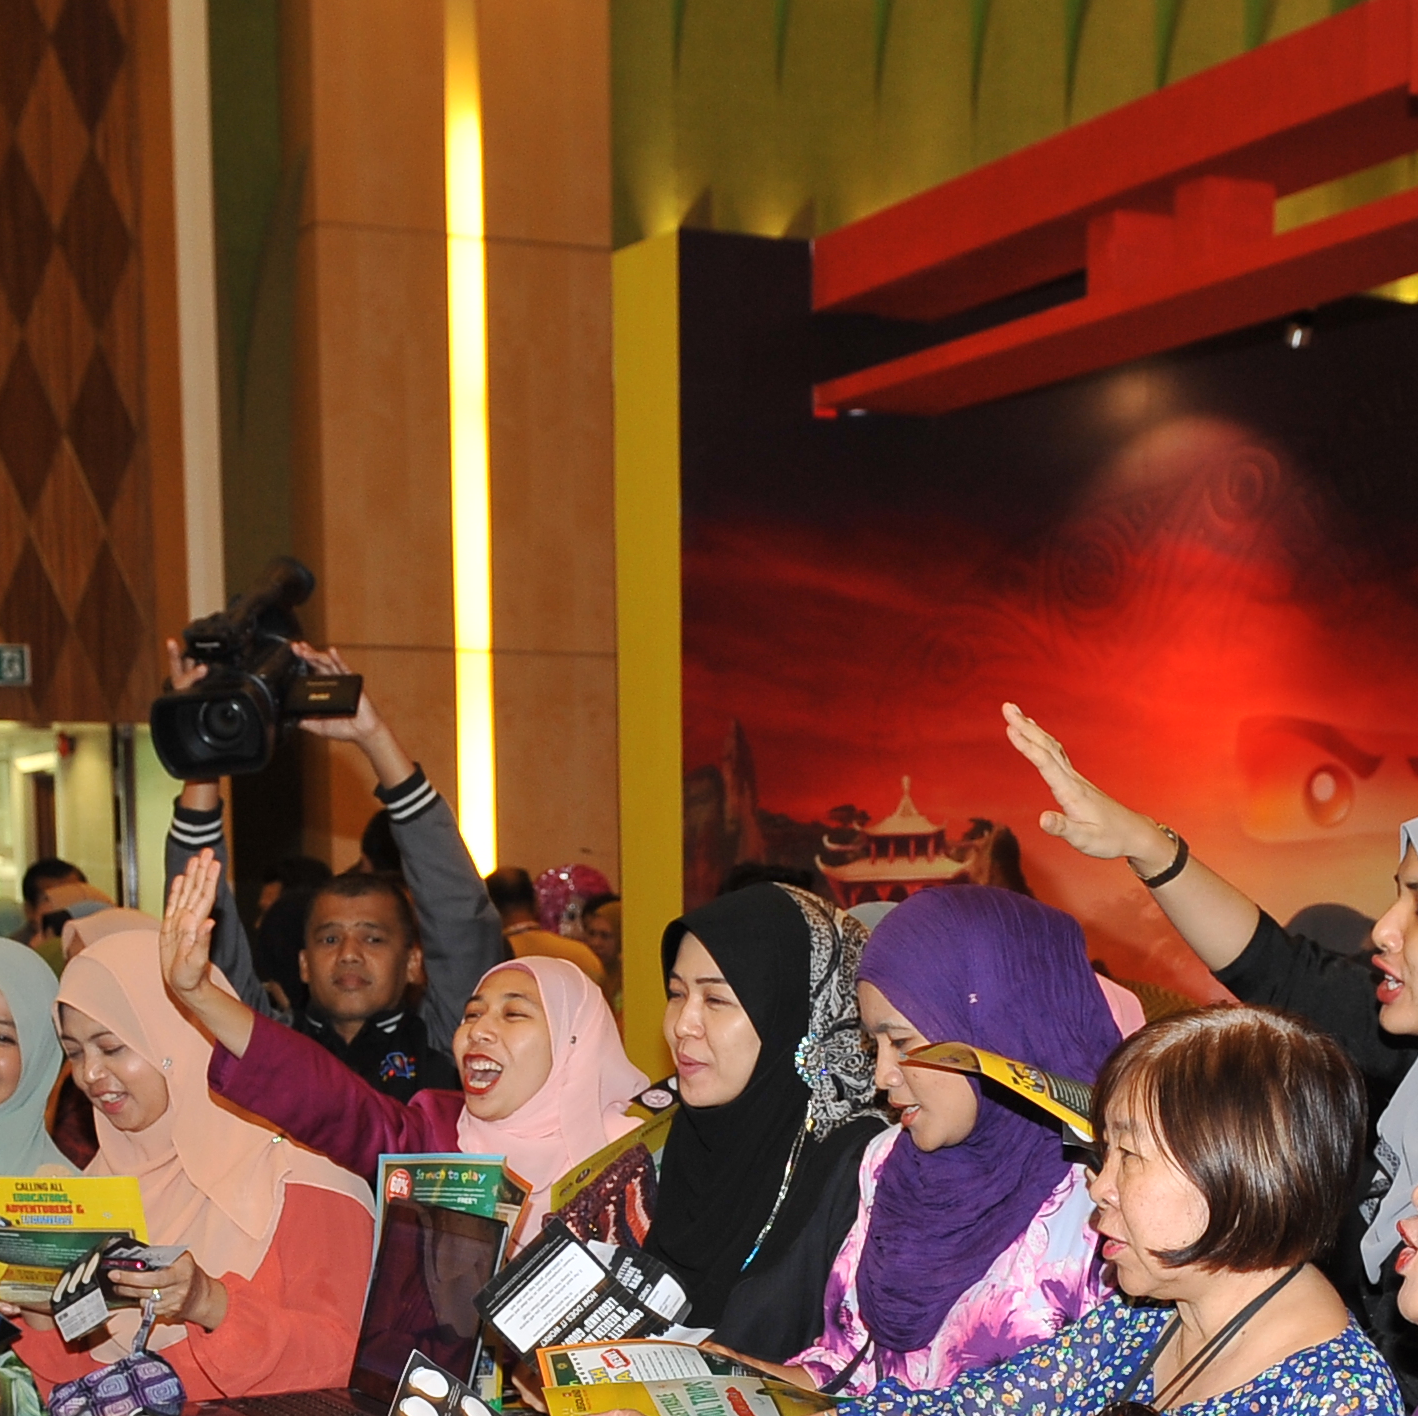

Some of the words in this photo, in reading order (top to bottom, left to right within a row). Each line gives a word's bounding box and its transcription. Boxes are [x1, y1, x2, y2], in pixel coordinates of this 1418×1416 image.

[461, 1169, 487, 1185] play
[585, 1291, 599, 1304] HOW
[567, 1302, 585, 1321] DOES
[559, 1318, 568, 1328] IT
[613, 1308, 645, 1340] COMPLETE
[540, 1324, 562, 1347] WORK?
